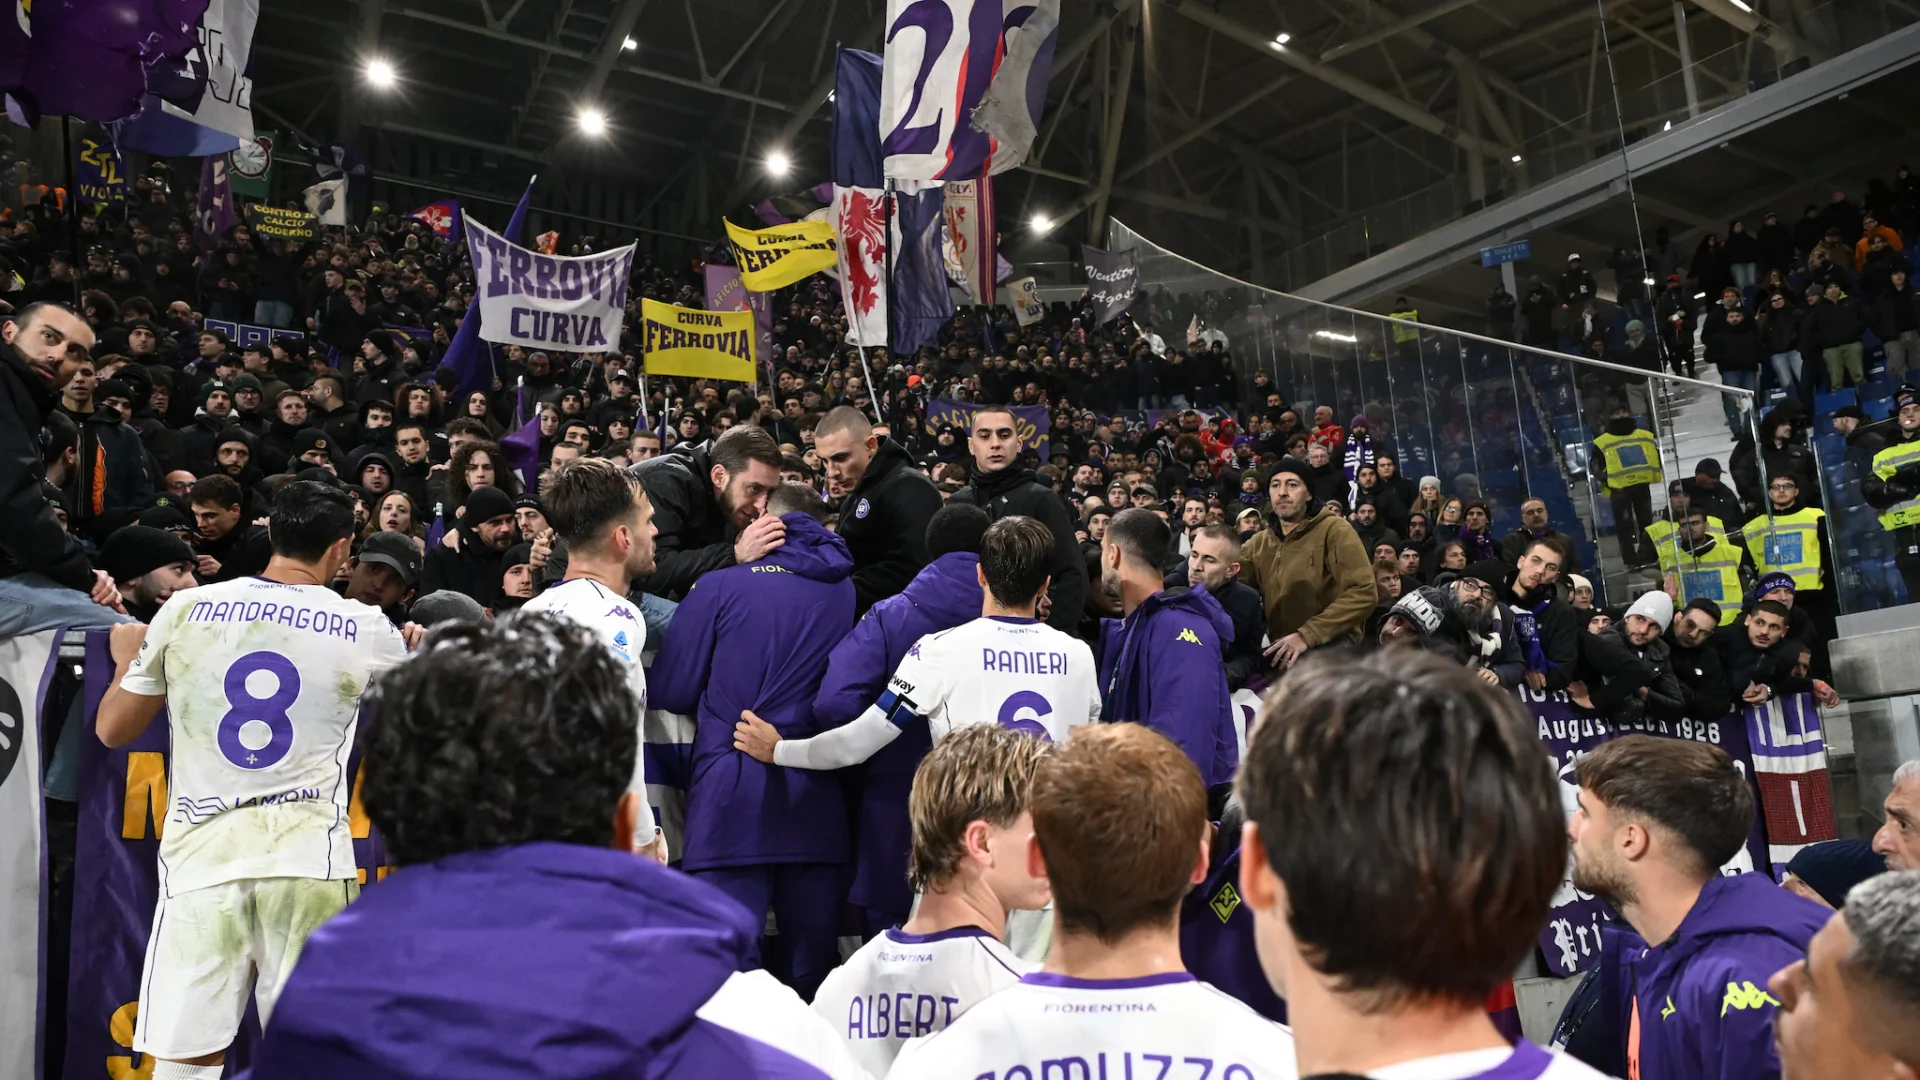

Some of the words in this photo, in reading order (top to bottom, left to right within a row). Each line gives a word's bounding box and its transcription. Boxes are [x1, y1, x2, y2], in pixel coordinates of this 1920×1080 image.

[79, 184, 124, 200] VIOLA
[254, 204, 302, 219] CONTRO
[263, 215, 306, 227] CALCIO
[255, 223, 313, 238] MODERNO
[465, 219, 634, 310] FERROVIA
[510, 307, 607, 346] CURVA
[677, 312, 723, 327] CURVA
[645, 318, 751, 362] FERROVIA
[249, 583, 304, 594] FIORENTINA
[188, 601, 358, 643] MANDRAGORA
[983, 648, 1067, 675] RANIERI
[217, 651, 302, 770] 8
[1676, 717, 1721, 744] 1926
[1044, 1002, 1157, 1014] FIORENTINA
